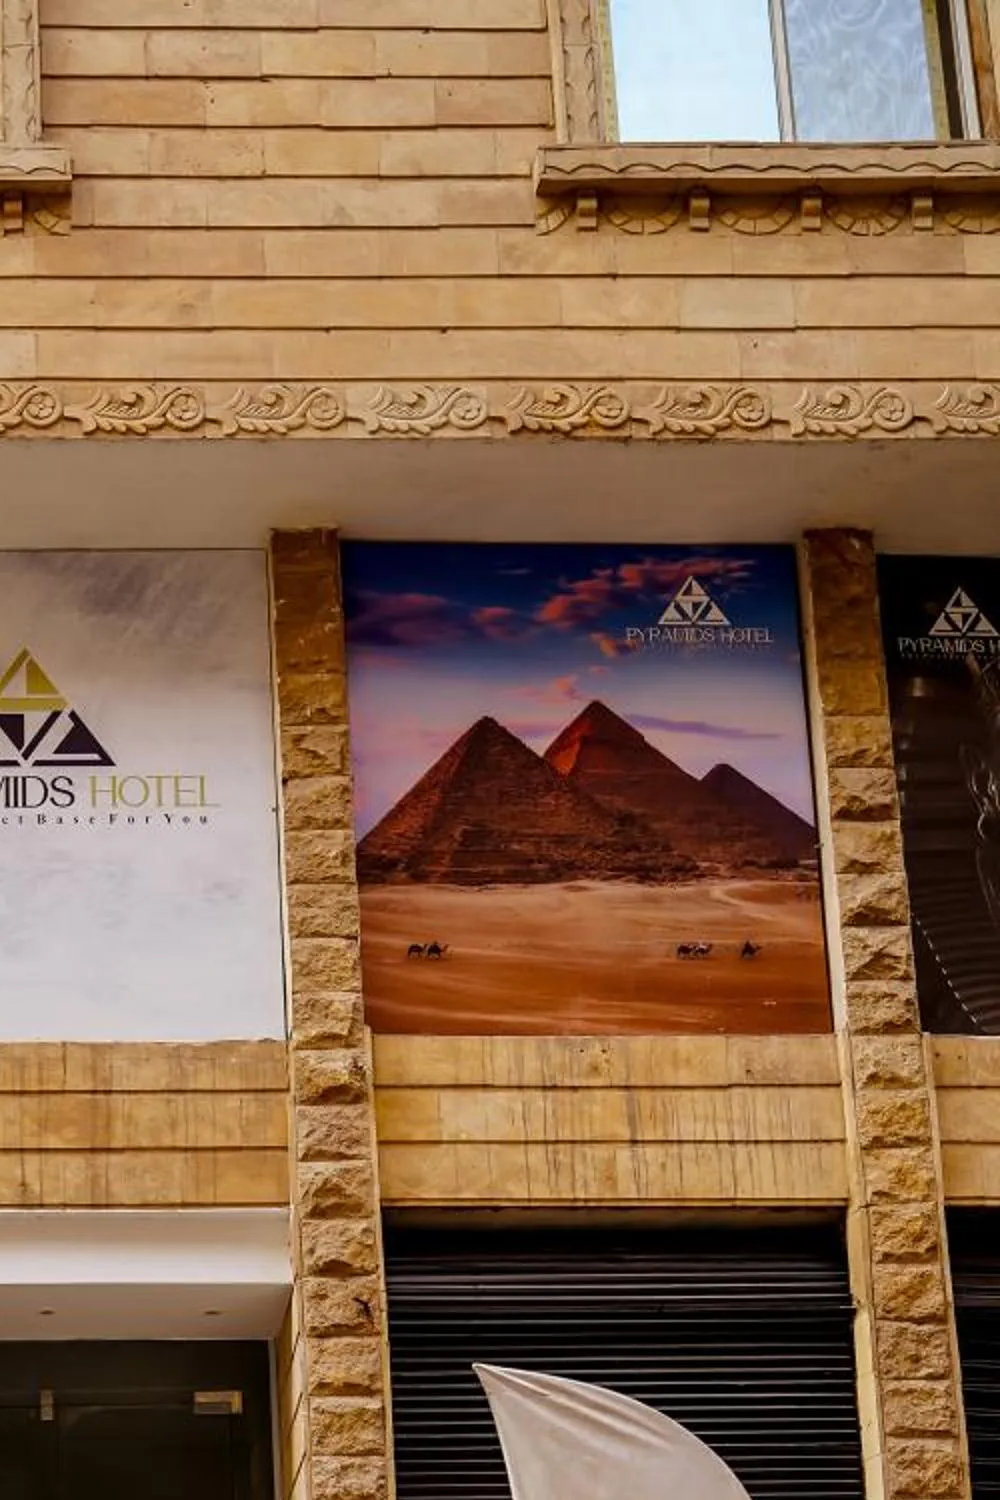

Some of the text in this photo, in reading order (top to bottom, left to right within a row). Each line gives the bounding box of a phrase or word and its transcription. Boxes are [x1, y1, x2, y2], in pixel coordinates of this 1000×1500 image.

[625, 627, 774, 643] PYRAMIDS HOTEL
[897, 637, 985, 653] PYRAMIDS
[89, 775, 221, 808] HOTEL
[37, 814, 96, 825] Base
[109, 814, 152, 825] For
[164, 814, 208, 825] You
